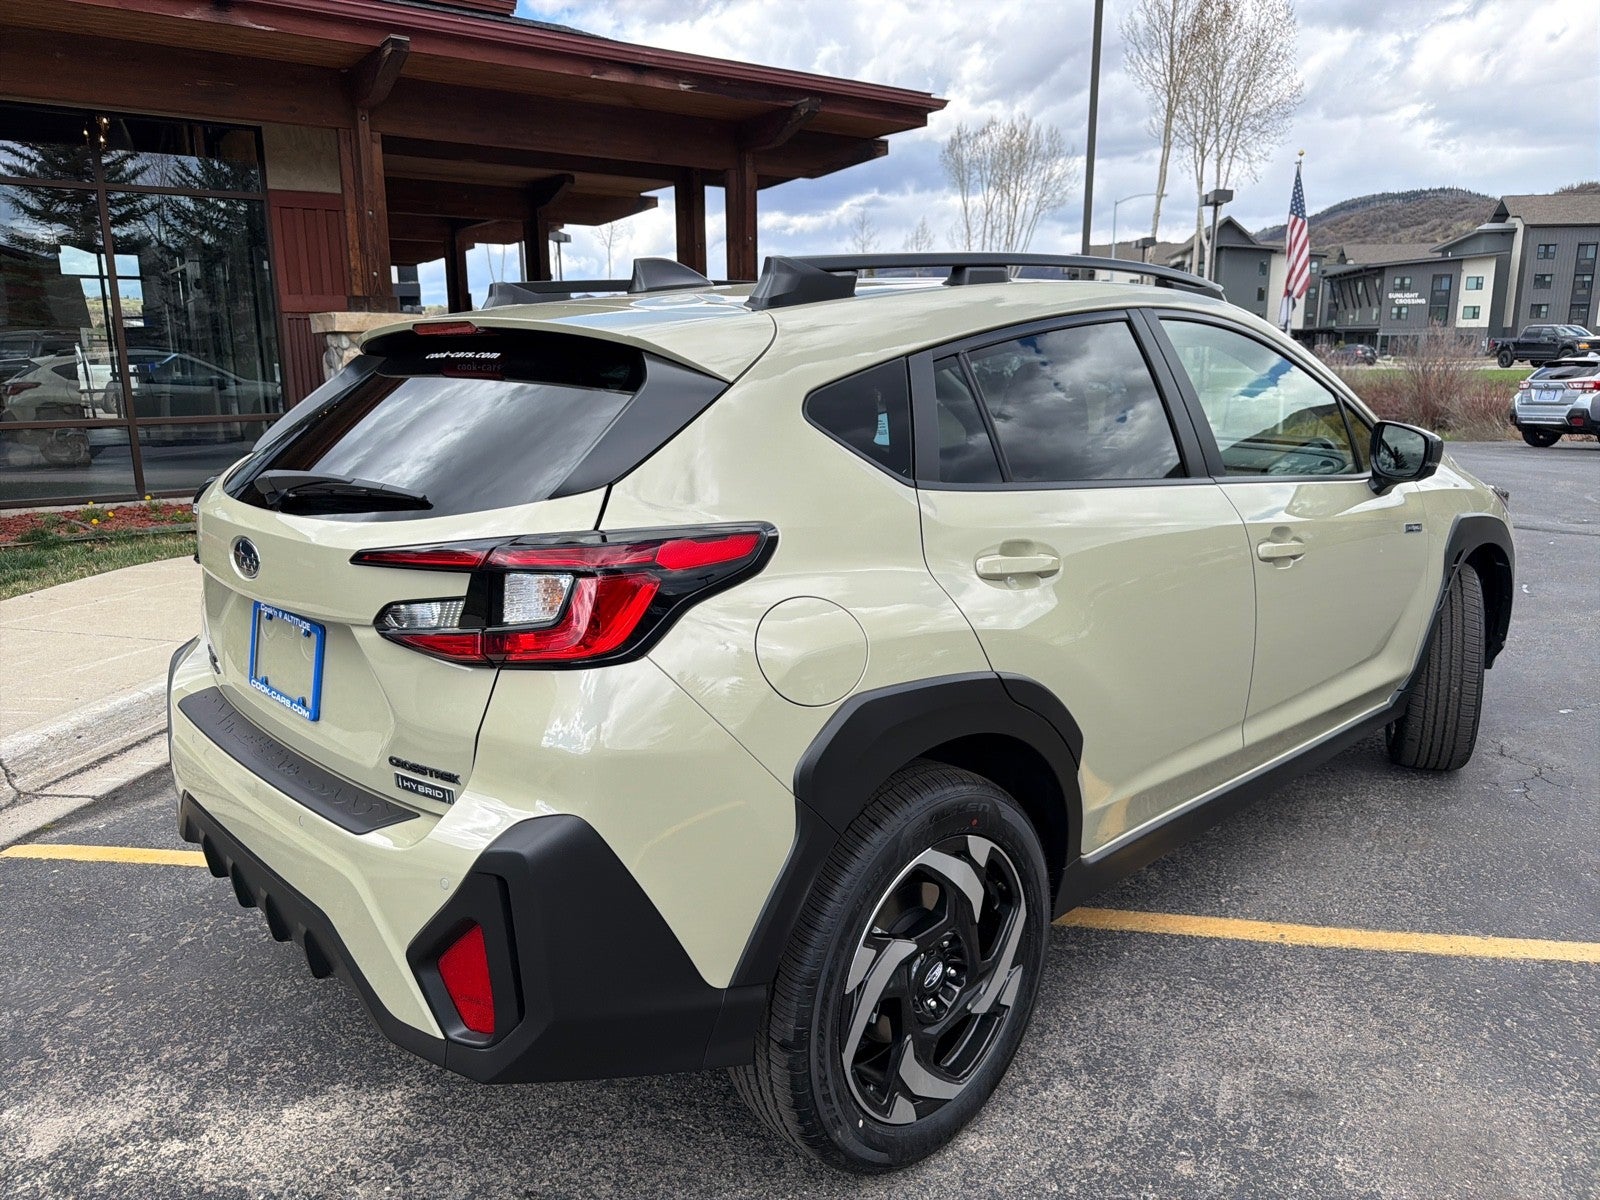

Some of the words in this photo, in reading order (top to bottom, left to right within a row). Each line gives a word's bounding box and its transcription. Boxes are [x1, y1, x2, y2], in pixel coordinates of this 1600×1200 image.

[283, 612, 311, 632] ALTITUDE
[388, 755, 462, 785] CROSSTREK
[403, 779, 444, 799] HYBRID
